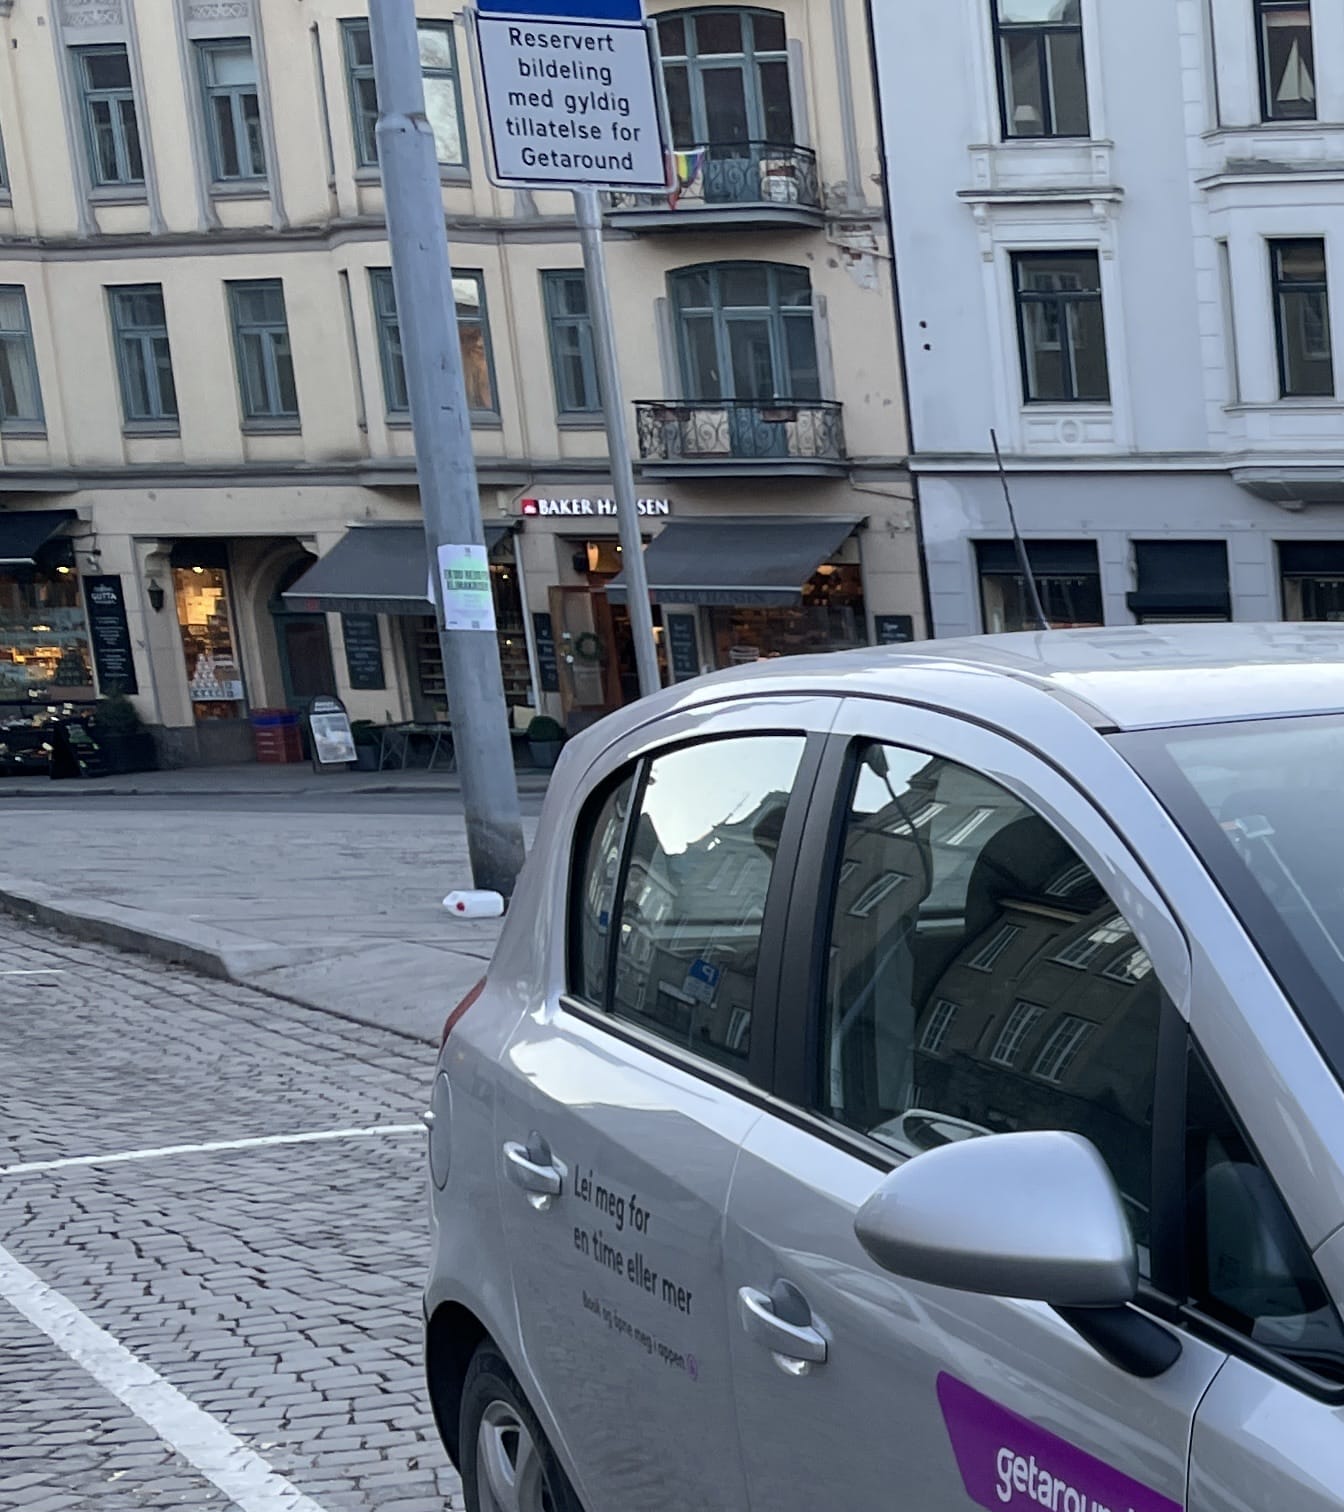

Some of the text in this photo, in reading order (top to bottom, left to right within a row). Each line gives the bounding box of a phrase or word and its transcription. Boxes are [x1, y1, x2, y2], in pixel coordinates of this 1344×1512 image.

[508, 27, 616, 52] Reservert
[518, 58, 612, 86] bildeling
[508, 89, 630, 116] med gyldig
[506, 117, 641, 142] tillatelse for
[521, 147, 633, 171] Getaround
[538, 498, 670, 516] BAKER HASEN
[574, 1164, 650, 1235] Lei meg for
[574, 1226, 693, 1315] en time eller mer
